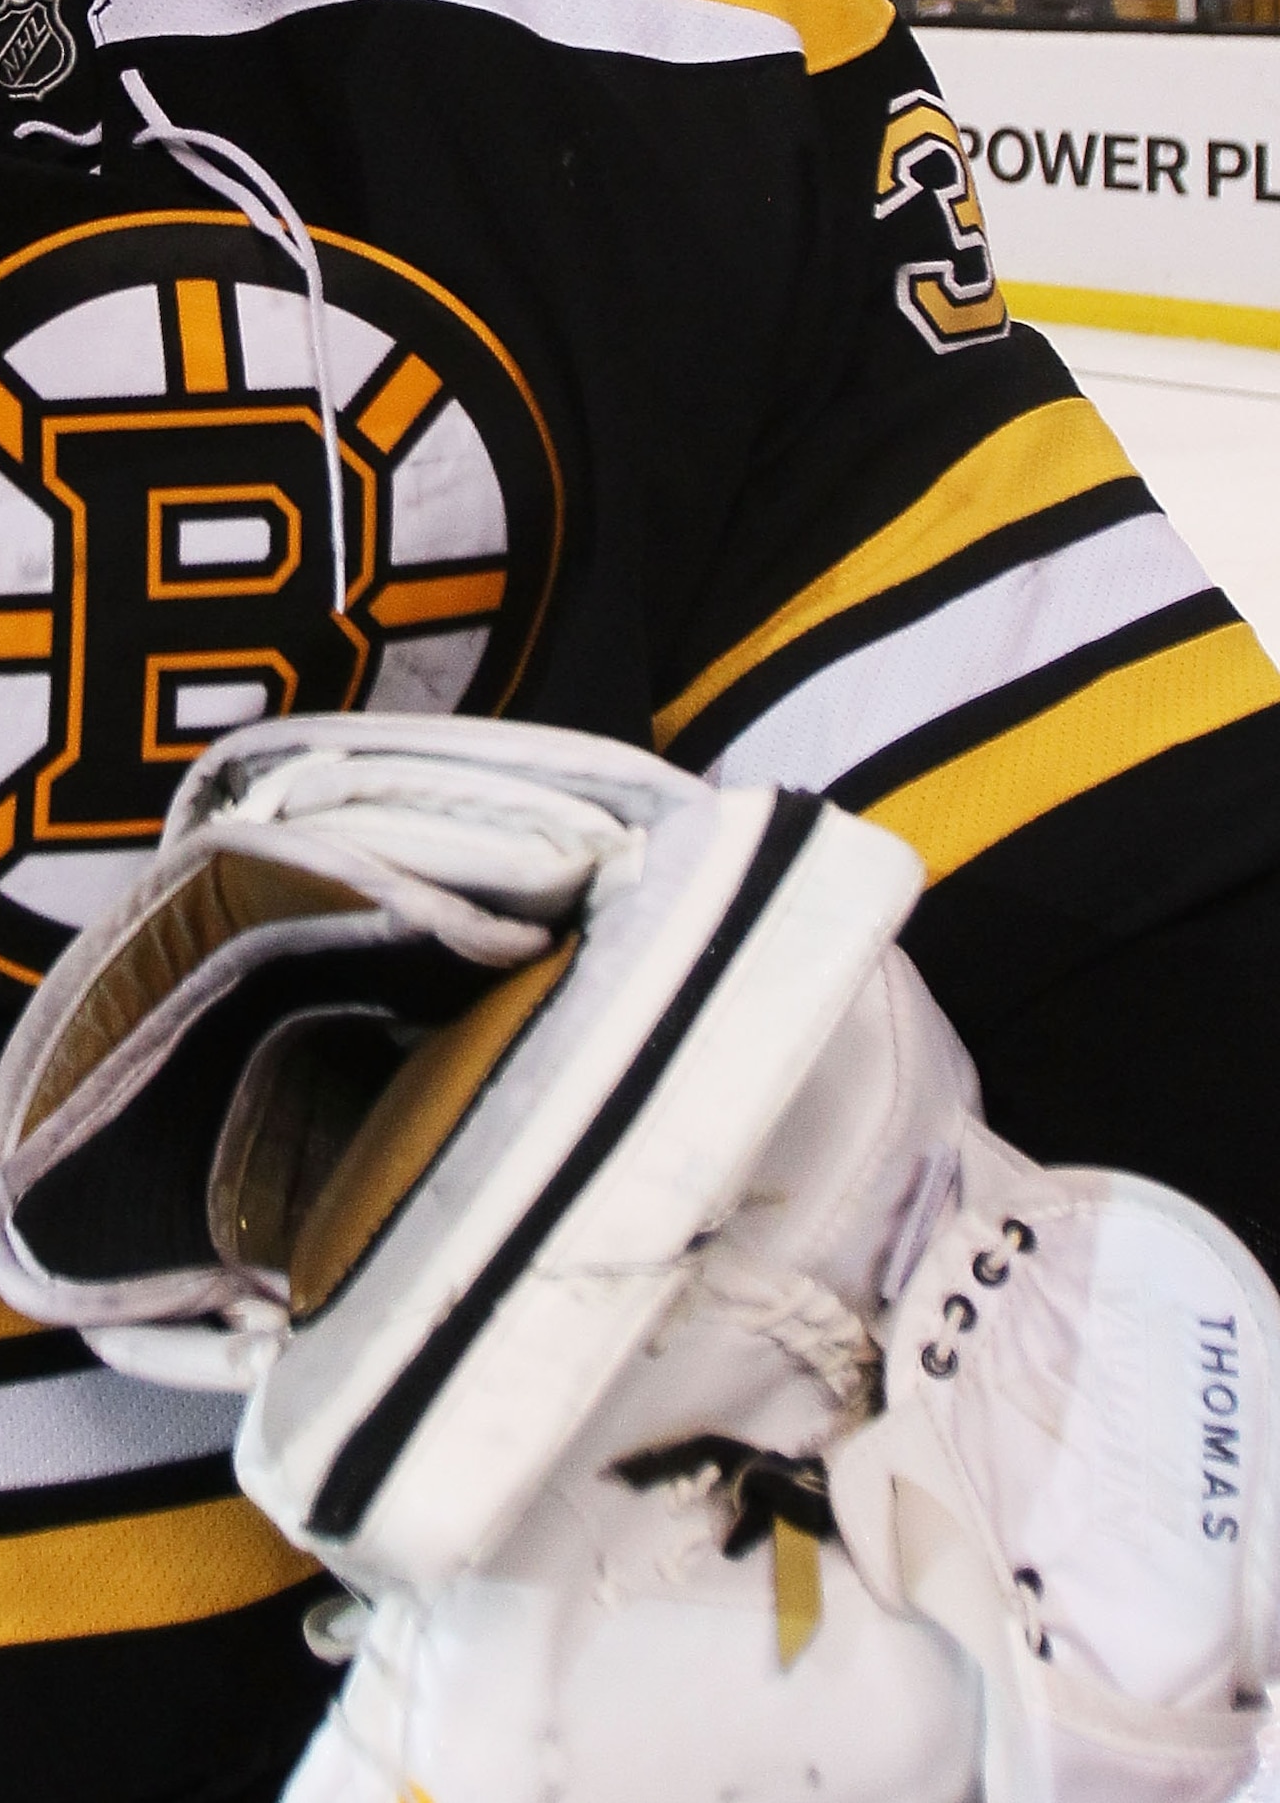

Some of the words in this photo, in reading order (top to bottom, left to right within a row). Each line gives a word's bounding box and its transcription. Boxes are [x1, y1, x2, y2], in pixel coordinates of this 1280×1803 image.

[2, 15, 49, 83] NHL
[873, 88, 1011, 355] 3
[33, 405, 376, 841] B
[1197, 1314, 1242, 1543] THOMAS
